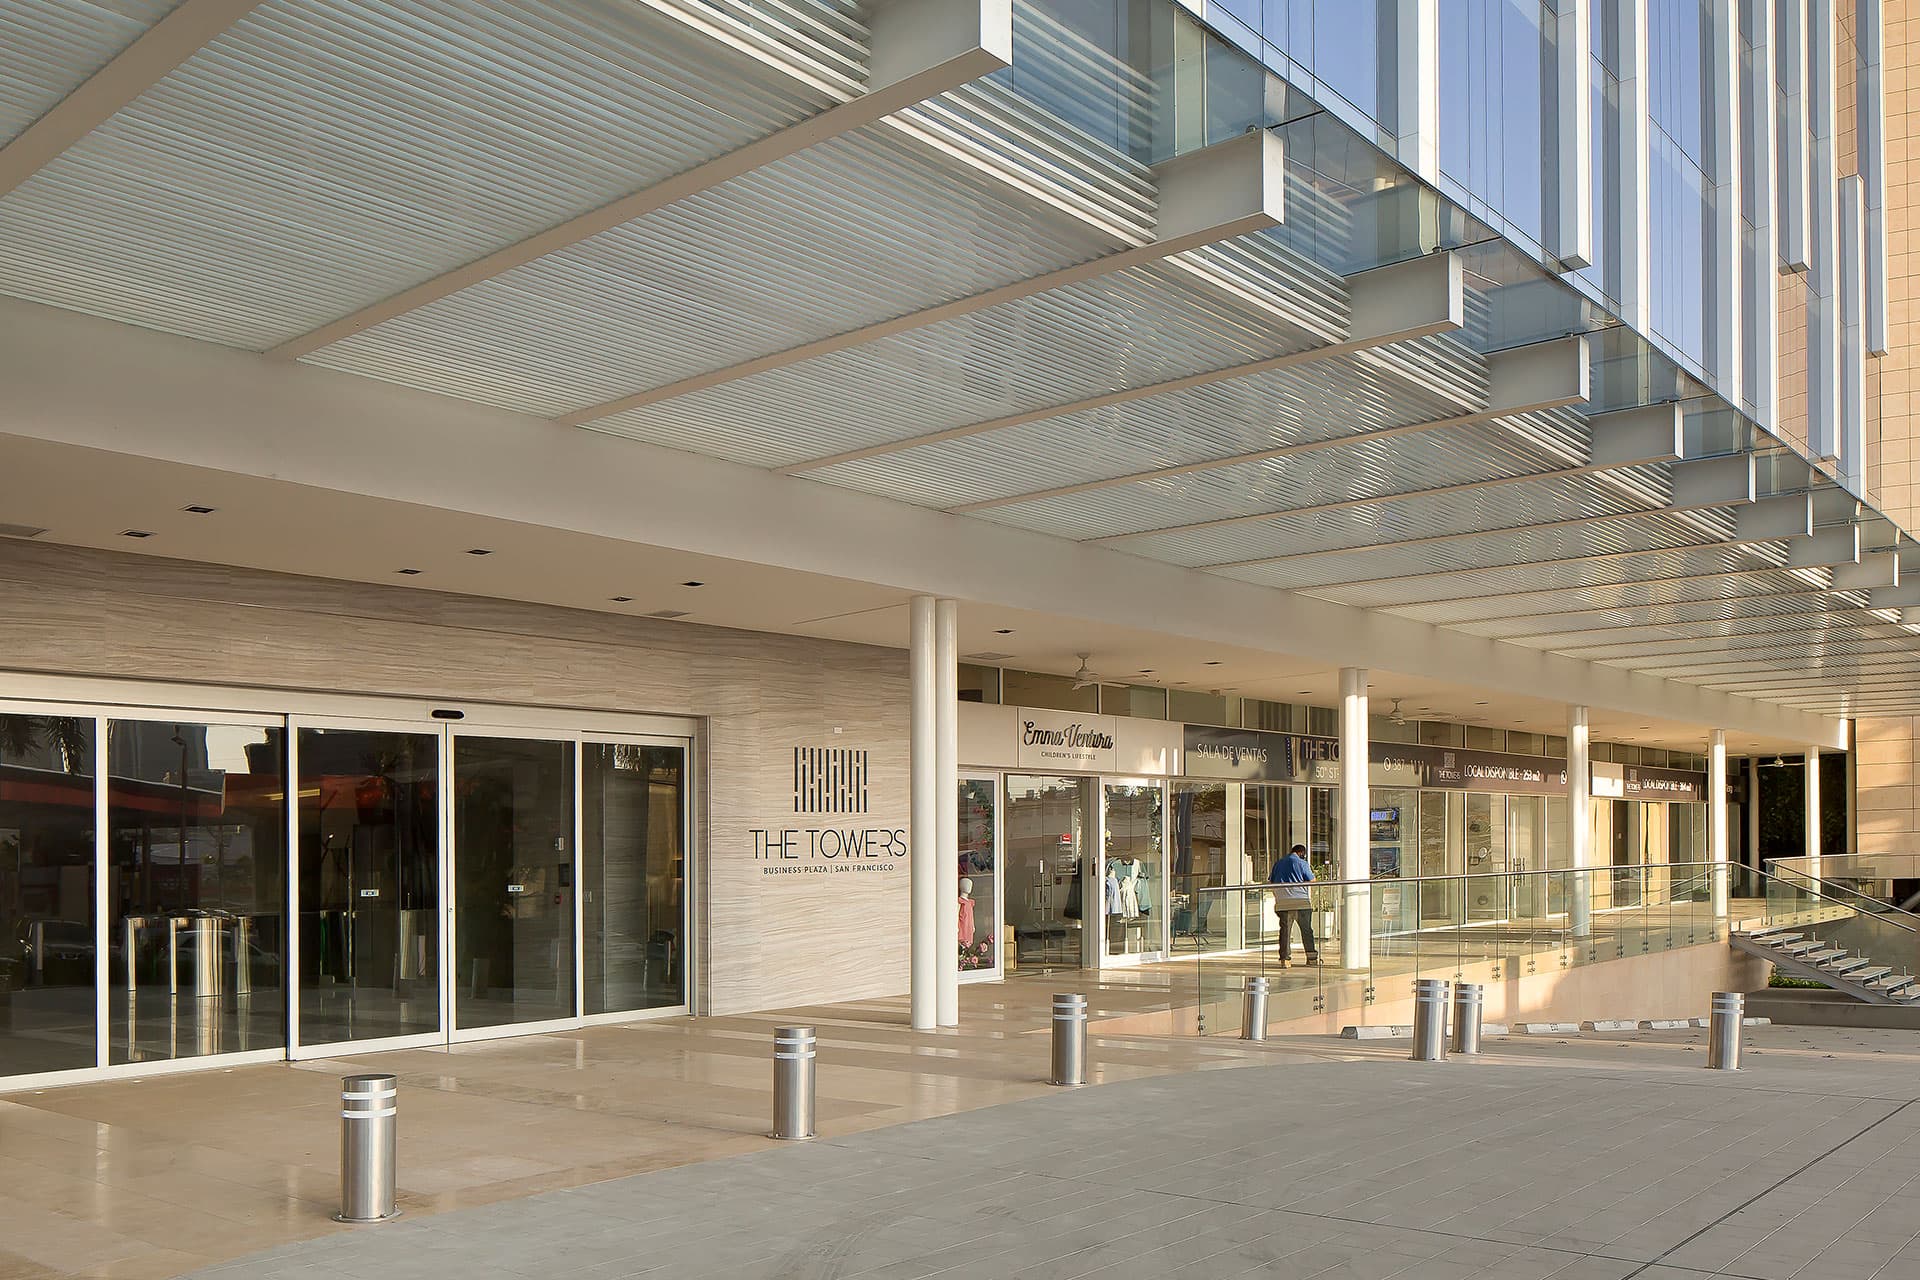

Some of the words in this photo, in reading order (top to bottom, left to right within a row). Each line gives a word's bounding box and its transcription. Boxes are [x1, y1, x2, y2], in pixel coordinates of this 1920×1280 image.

[1023, 721, 1064, 746] Emma
[1064, 724, 1114, 749] Ventura
[1197, 743, 1221, 760] SALA
[1222, 745, 1234, 760] DE
[1234, 746, 1268, 763] VENTAS
[1303, 739, 1326, 761] THE
[1464, 764, 1485, 778] LOCAL
[748, 829, 799, 860] THE
[805, 829, 907, 860] TOWERS
[763, 866, 802, 875] BUSINESS
[804, 865, 829, 874] PLAZA
[835, 865, 850, 873] SAN
[852, 863, 894, 873] FRANCISCO
